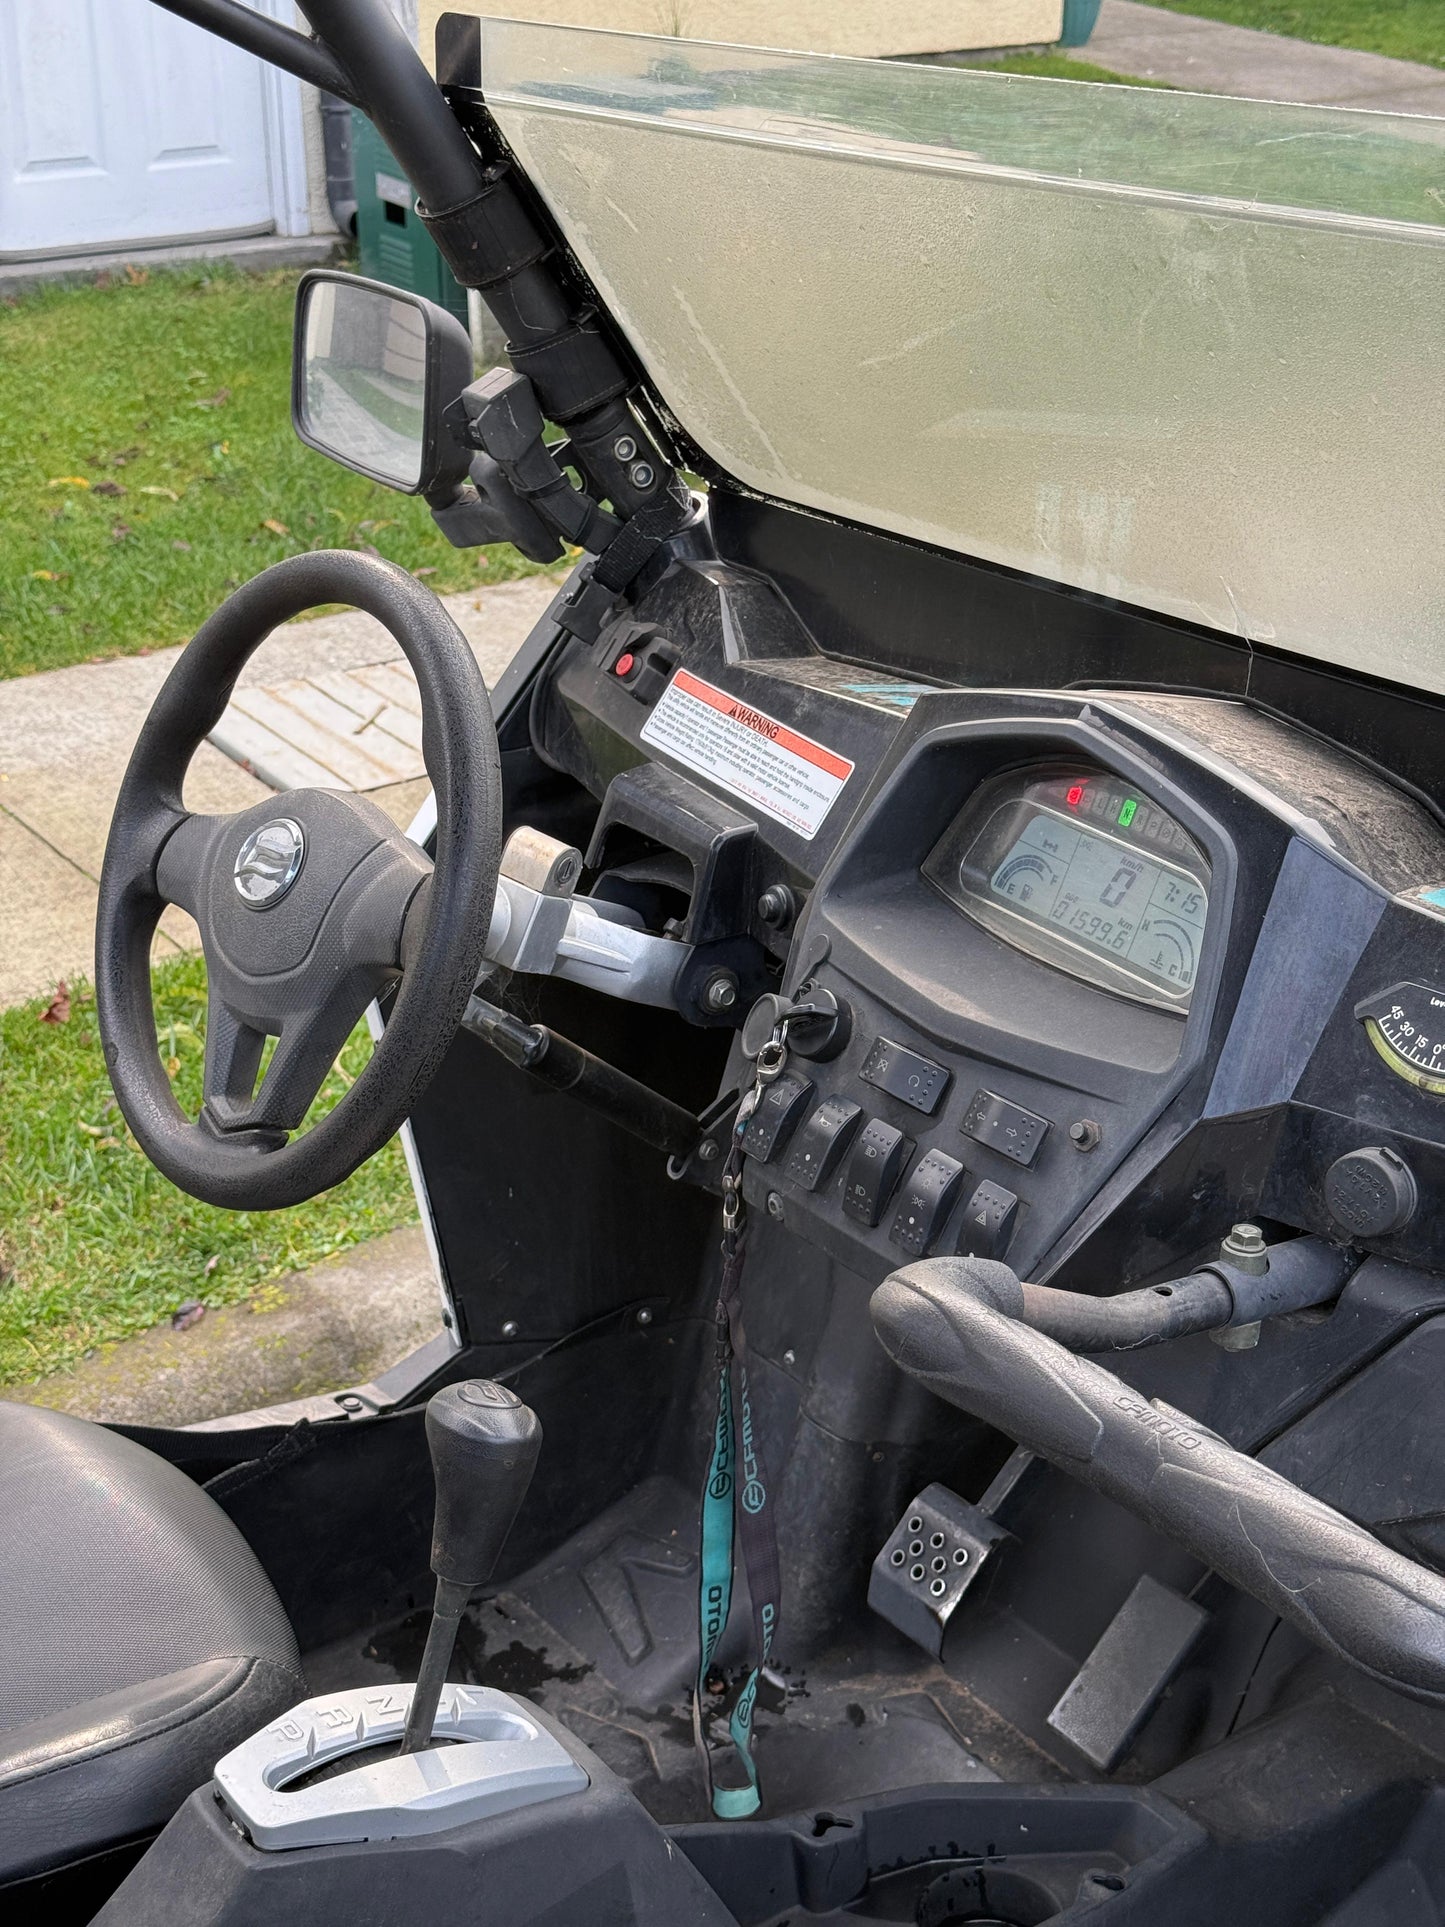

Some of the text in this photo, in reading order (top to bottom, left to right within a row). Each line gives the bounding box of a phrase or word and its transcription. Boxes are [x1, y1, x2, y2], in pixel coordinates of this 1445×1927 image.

[735, 706, 780, 739] WARNING
[1120, 857, 1144, 874] km/h
[1006, 883, 1016, 895] E
[1049, 874, 1059, 886] F
[1099, 867, 1137, 908] 0
[1163, 881, 1203, 915] 7:15
[1051, 900, 1128, 951] 01599.6
[1117, 916, 1134, 931] km
[1141, 918, 1151, 932] H
[1391, 1005, 1404, 1020] 45
[1399, 1021, 1415, 1037] 30
[1414, 1034, 1429, 1048] 15
[1112, 1396, 1202, 1450] CFMOTO
[363, 1694, 405, 1716] N
